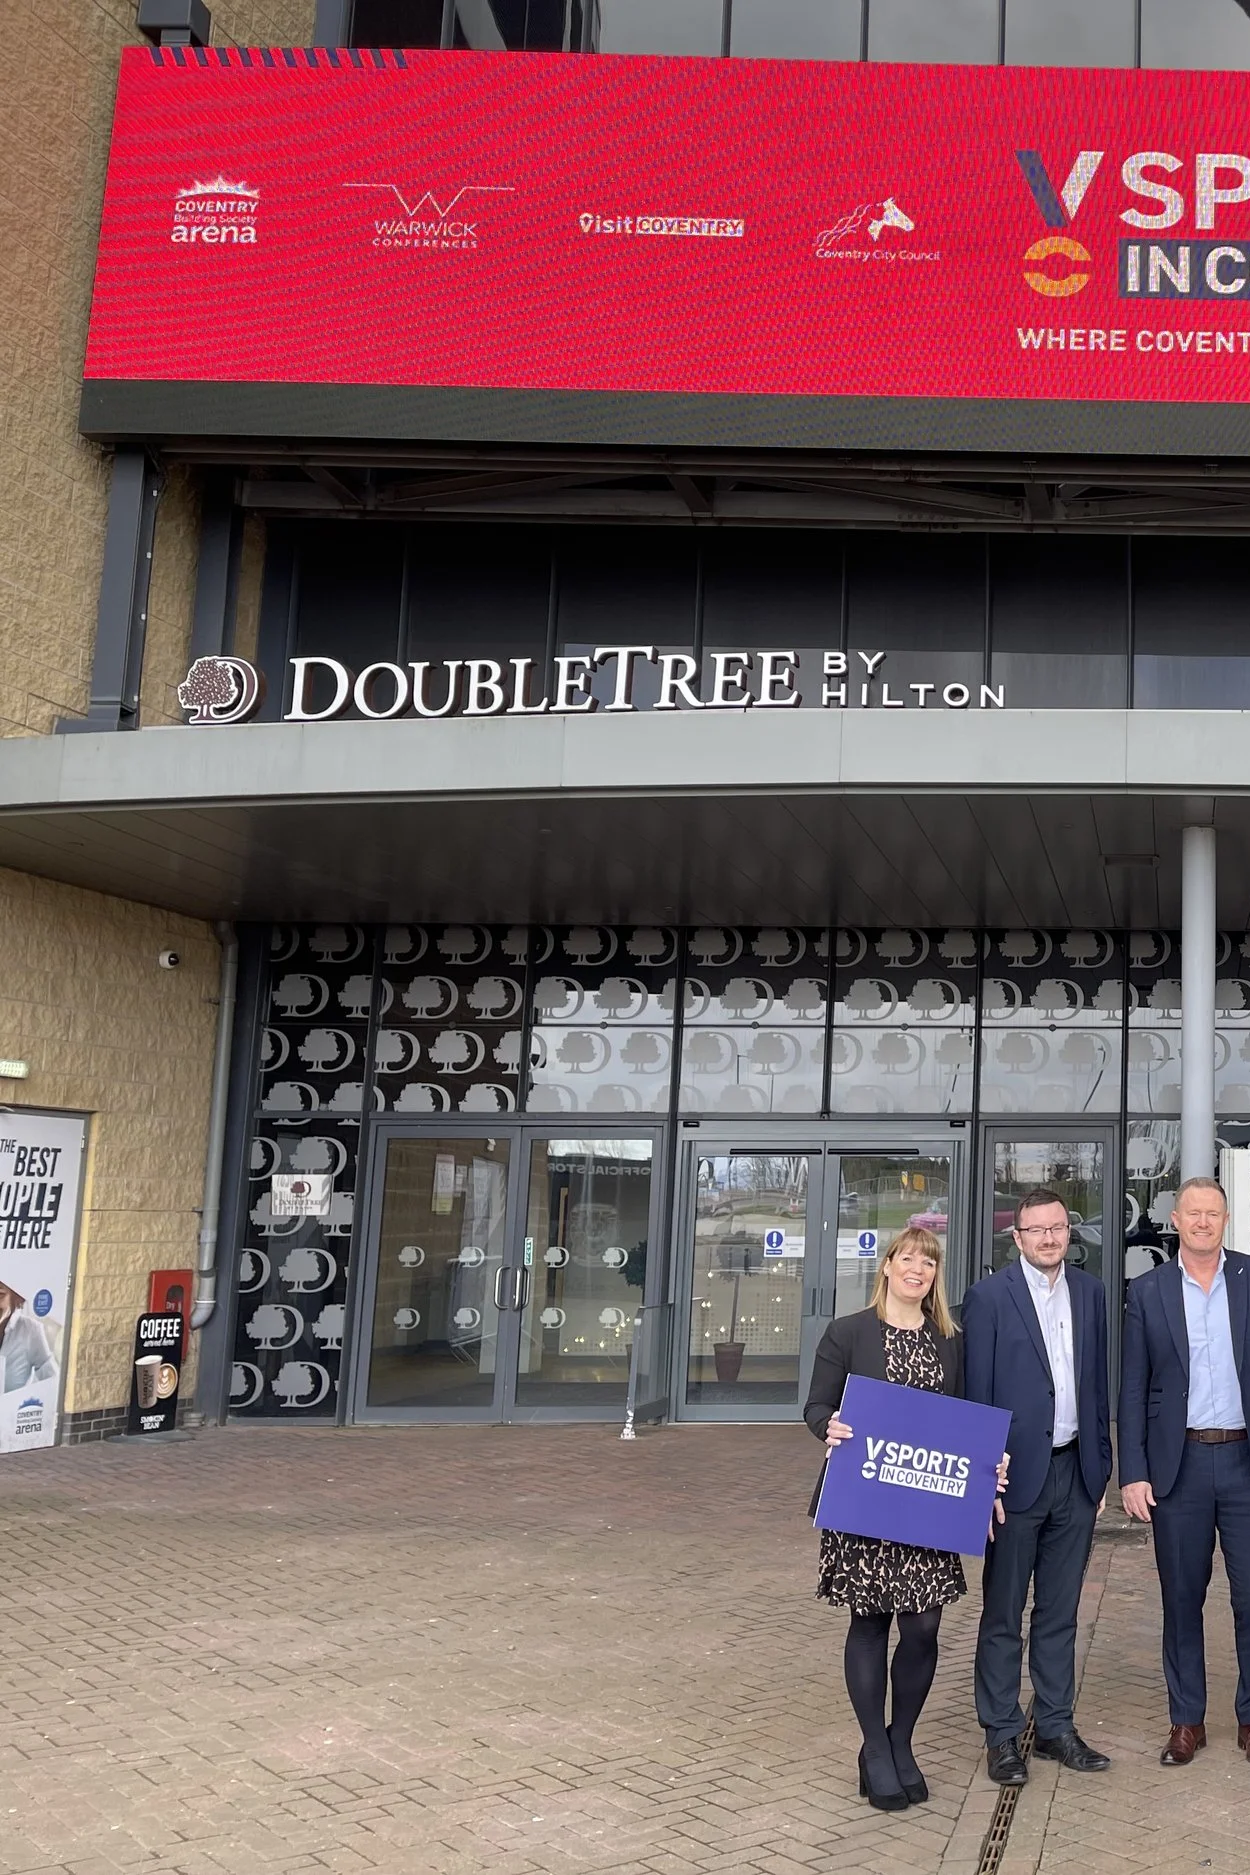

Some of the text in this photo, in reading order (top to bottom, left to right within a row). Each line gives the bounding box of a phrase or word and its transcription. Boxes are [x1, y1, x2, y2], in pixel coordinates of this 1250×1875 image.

[175, 201, 258, 213] COVENTRY
[220, 214, 257, 225] Society
[374, 220, 478, 237] WARWICK
[578, 212, 742, 236] Visit COVENTRY
[171, 225, 257, 243] arena
[372, 237, 477, 248] CONFERENCES
[816, 248, 940, 263] Coventry City Council
[1126, 245, 1191, 294] IN
[1017, 328, 1128, 352] WHERE
[823, 651, 887, 676] BY
[822, 682, 1005, 709] HILTON
[0, 1139, 17, 1153] THE
[13, 1146, 62, 1178] BEST
[3, 1219, 51, 1250] HERE
[140, 1318, 181, 1339] COFFEE
[15, 1423, 42, 1435] arena
[883, 1442, 970, 1480] SPORTS
[881, 1465, 965, 1495] IN COVENTRY
